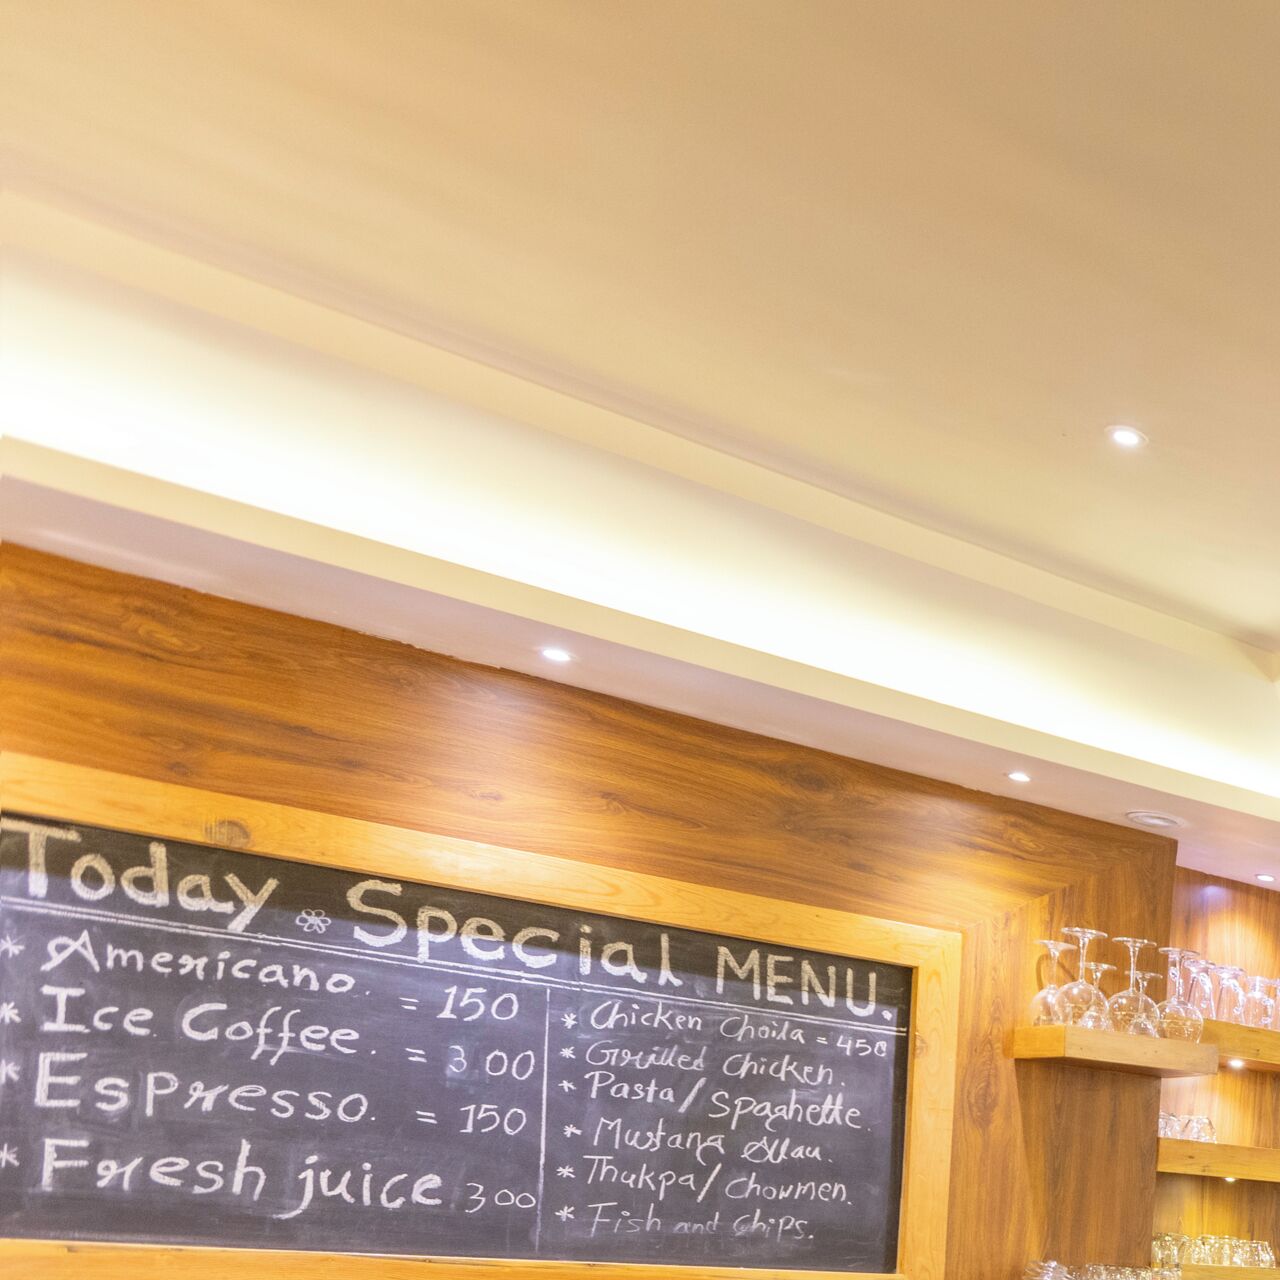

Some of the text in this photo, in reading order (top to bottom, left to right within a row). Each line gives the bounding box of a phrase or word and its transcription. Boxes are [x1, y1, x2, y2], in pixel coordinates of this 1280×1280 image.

[0, 818, 280, 932] Today
[346, 878, 682, 987] Special
[437, 985, 519, 1021] 150
[590, 1000, 702, 1031] Chicken
[585, 1040, 707, 1070] Grilled
[460, 1104, 527, 1135] 150
[41, 1138, 536, 1219] Fresh juice 300
[588, 1202, 661, 1237] Fish
[672, 1212, 719, 1234] and
